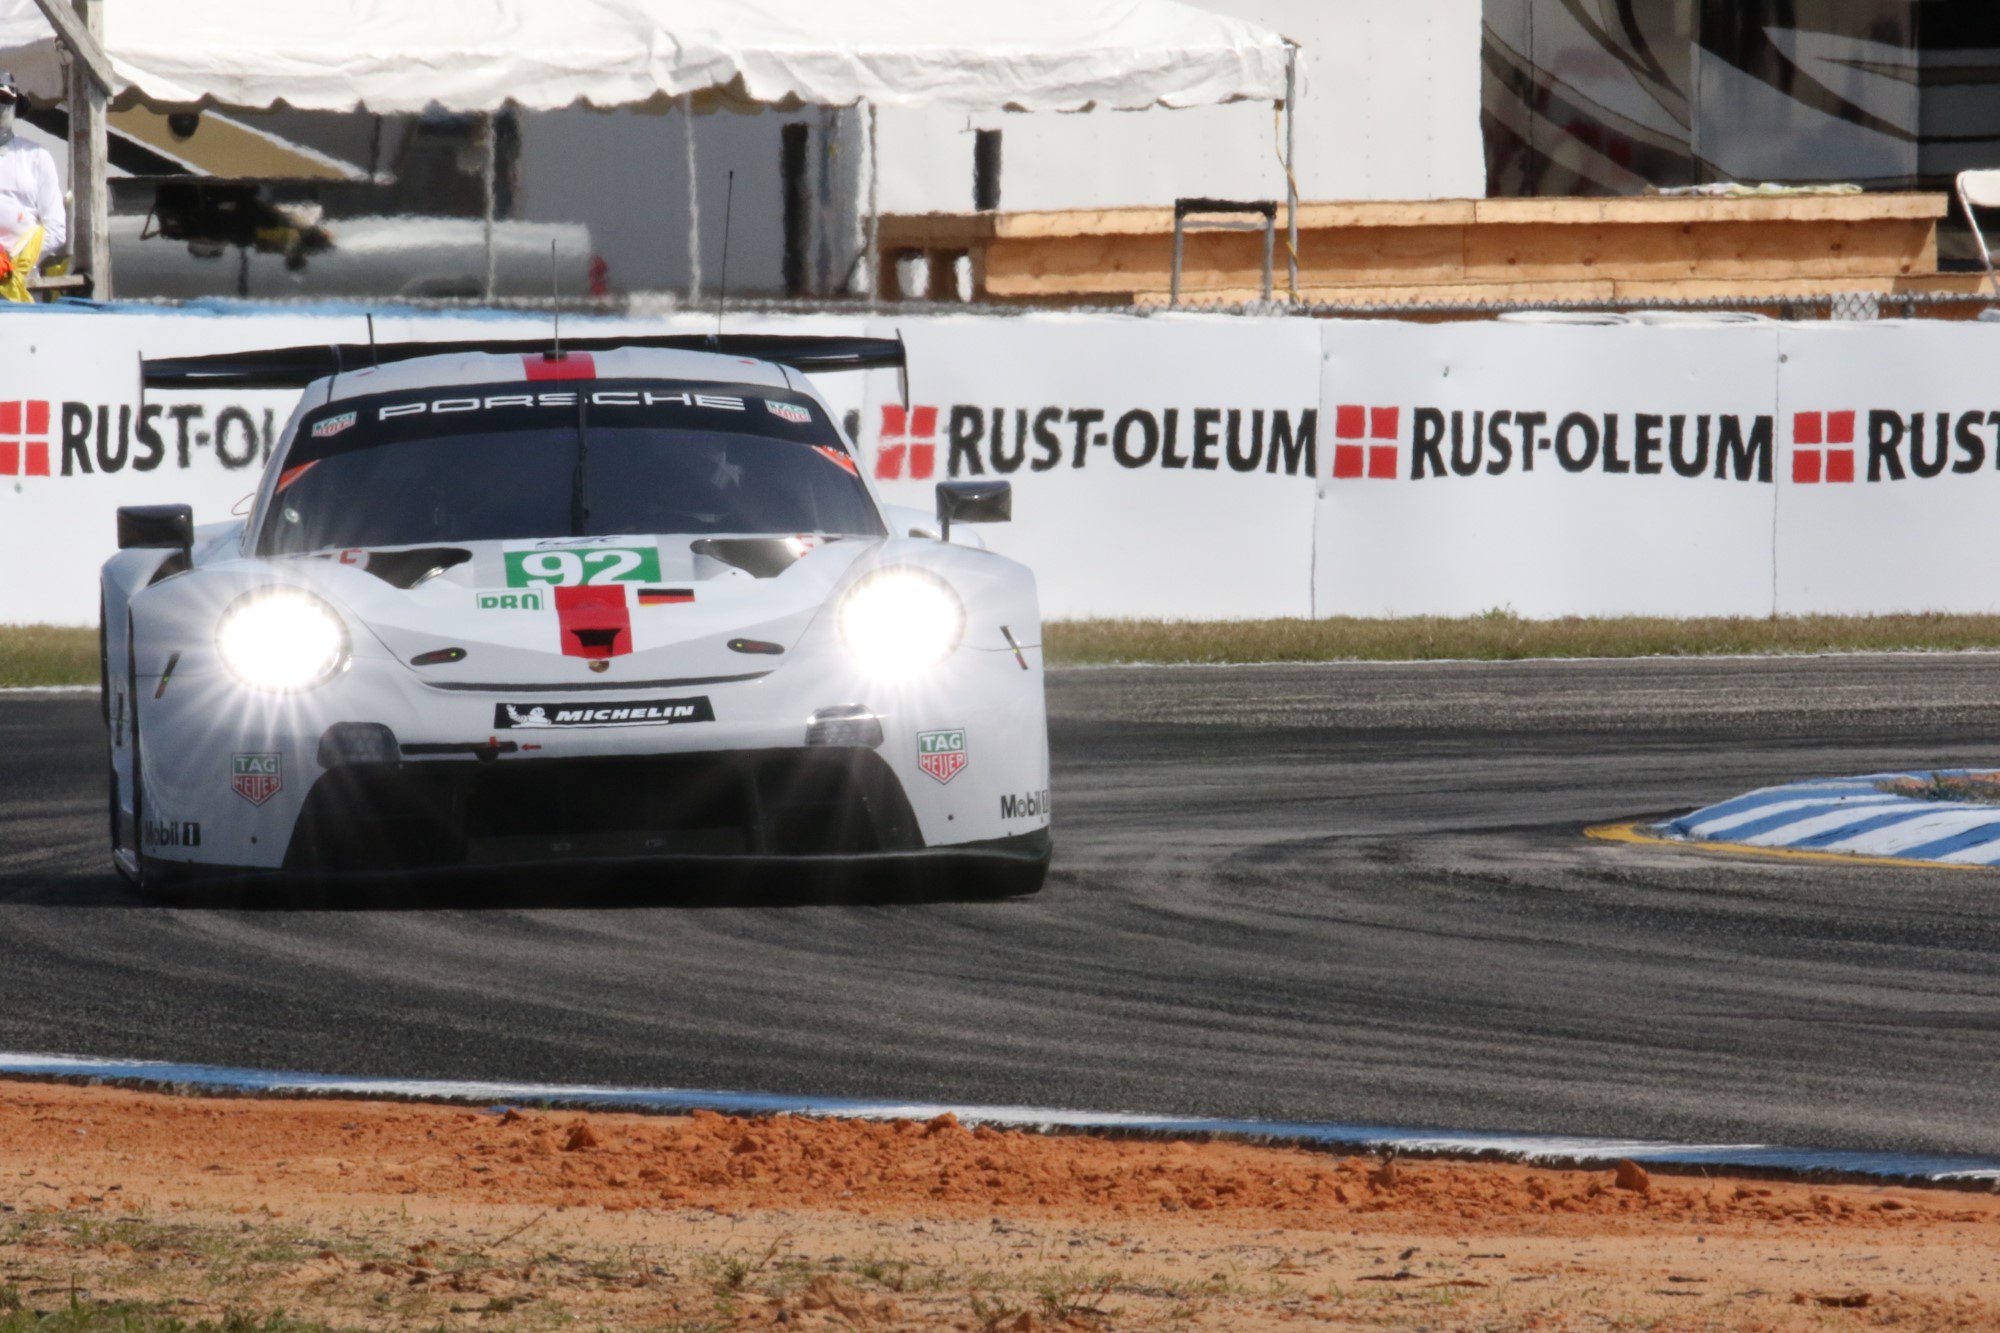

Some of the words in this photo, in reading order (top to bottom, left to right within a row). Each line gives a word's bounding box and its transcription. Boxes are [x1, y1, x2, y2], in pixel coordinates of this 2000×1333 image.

[378, 392, 746, 421] PORSCHE
[947, 404, 1318, 477] RUST-OLEUM
[1411, 406, 1774, 483] RUST-OLEUM
[521, 550, 646, 587] 92
[555, 705, 695, 722] MICHELIN
[921, 733, 962, 751] TAG
[235, 757, 277, 773] TAG
[922, 753, 964, 778] HEUER
[235, 776, 279, 800] HEUER
[1001, 790, 1041, 819] Mobil
